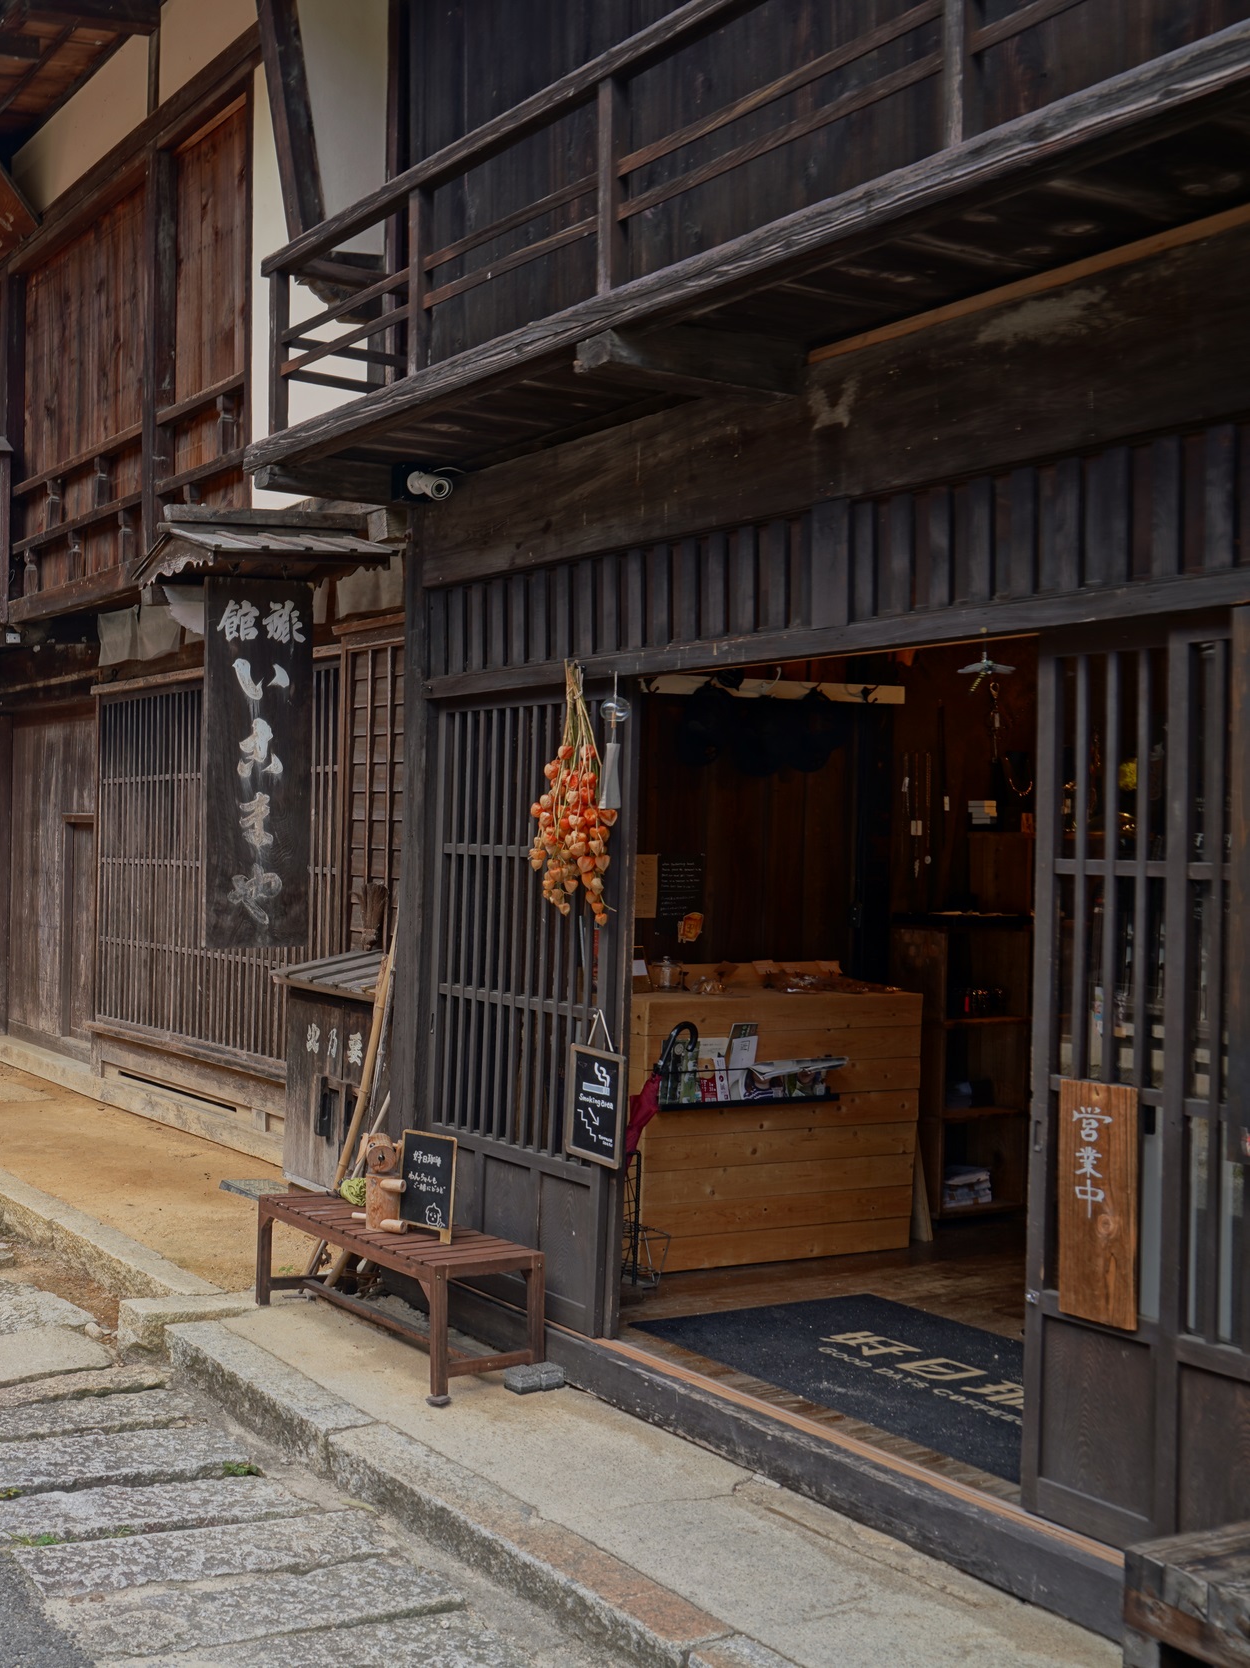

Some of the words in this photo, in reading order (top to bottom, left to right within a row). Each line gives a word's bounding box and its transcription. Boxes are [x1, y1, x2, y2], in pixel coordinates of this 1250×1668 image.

[217, 599, 306, 644] 旅館
[578, 1092, 601, 1107] Smoking
[1072, 1106, 1112, 1218] 営業中
[817, 1346, 873, 1368] GOOD
[872, 1367, 930, 1388] DAYS
